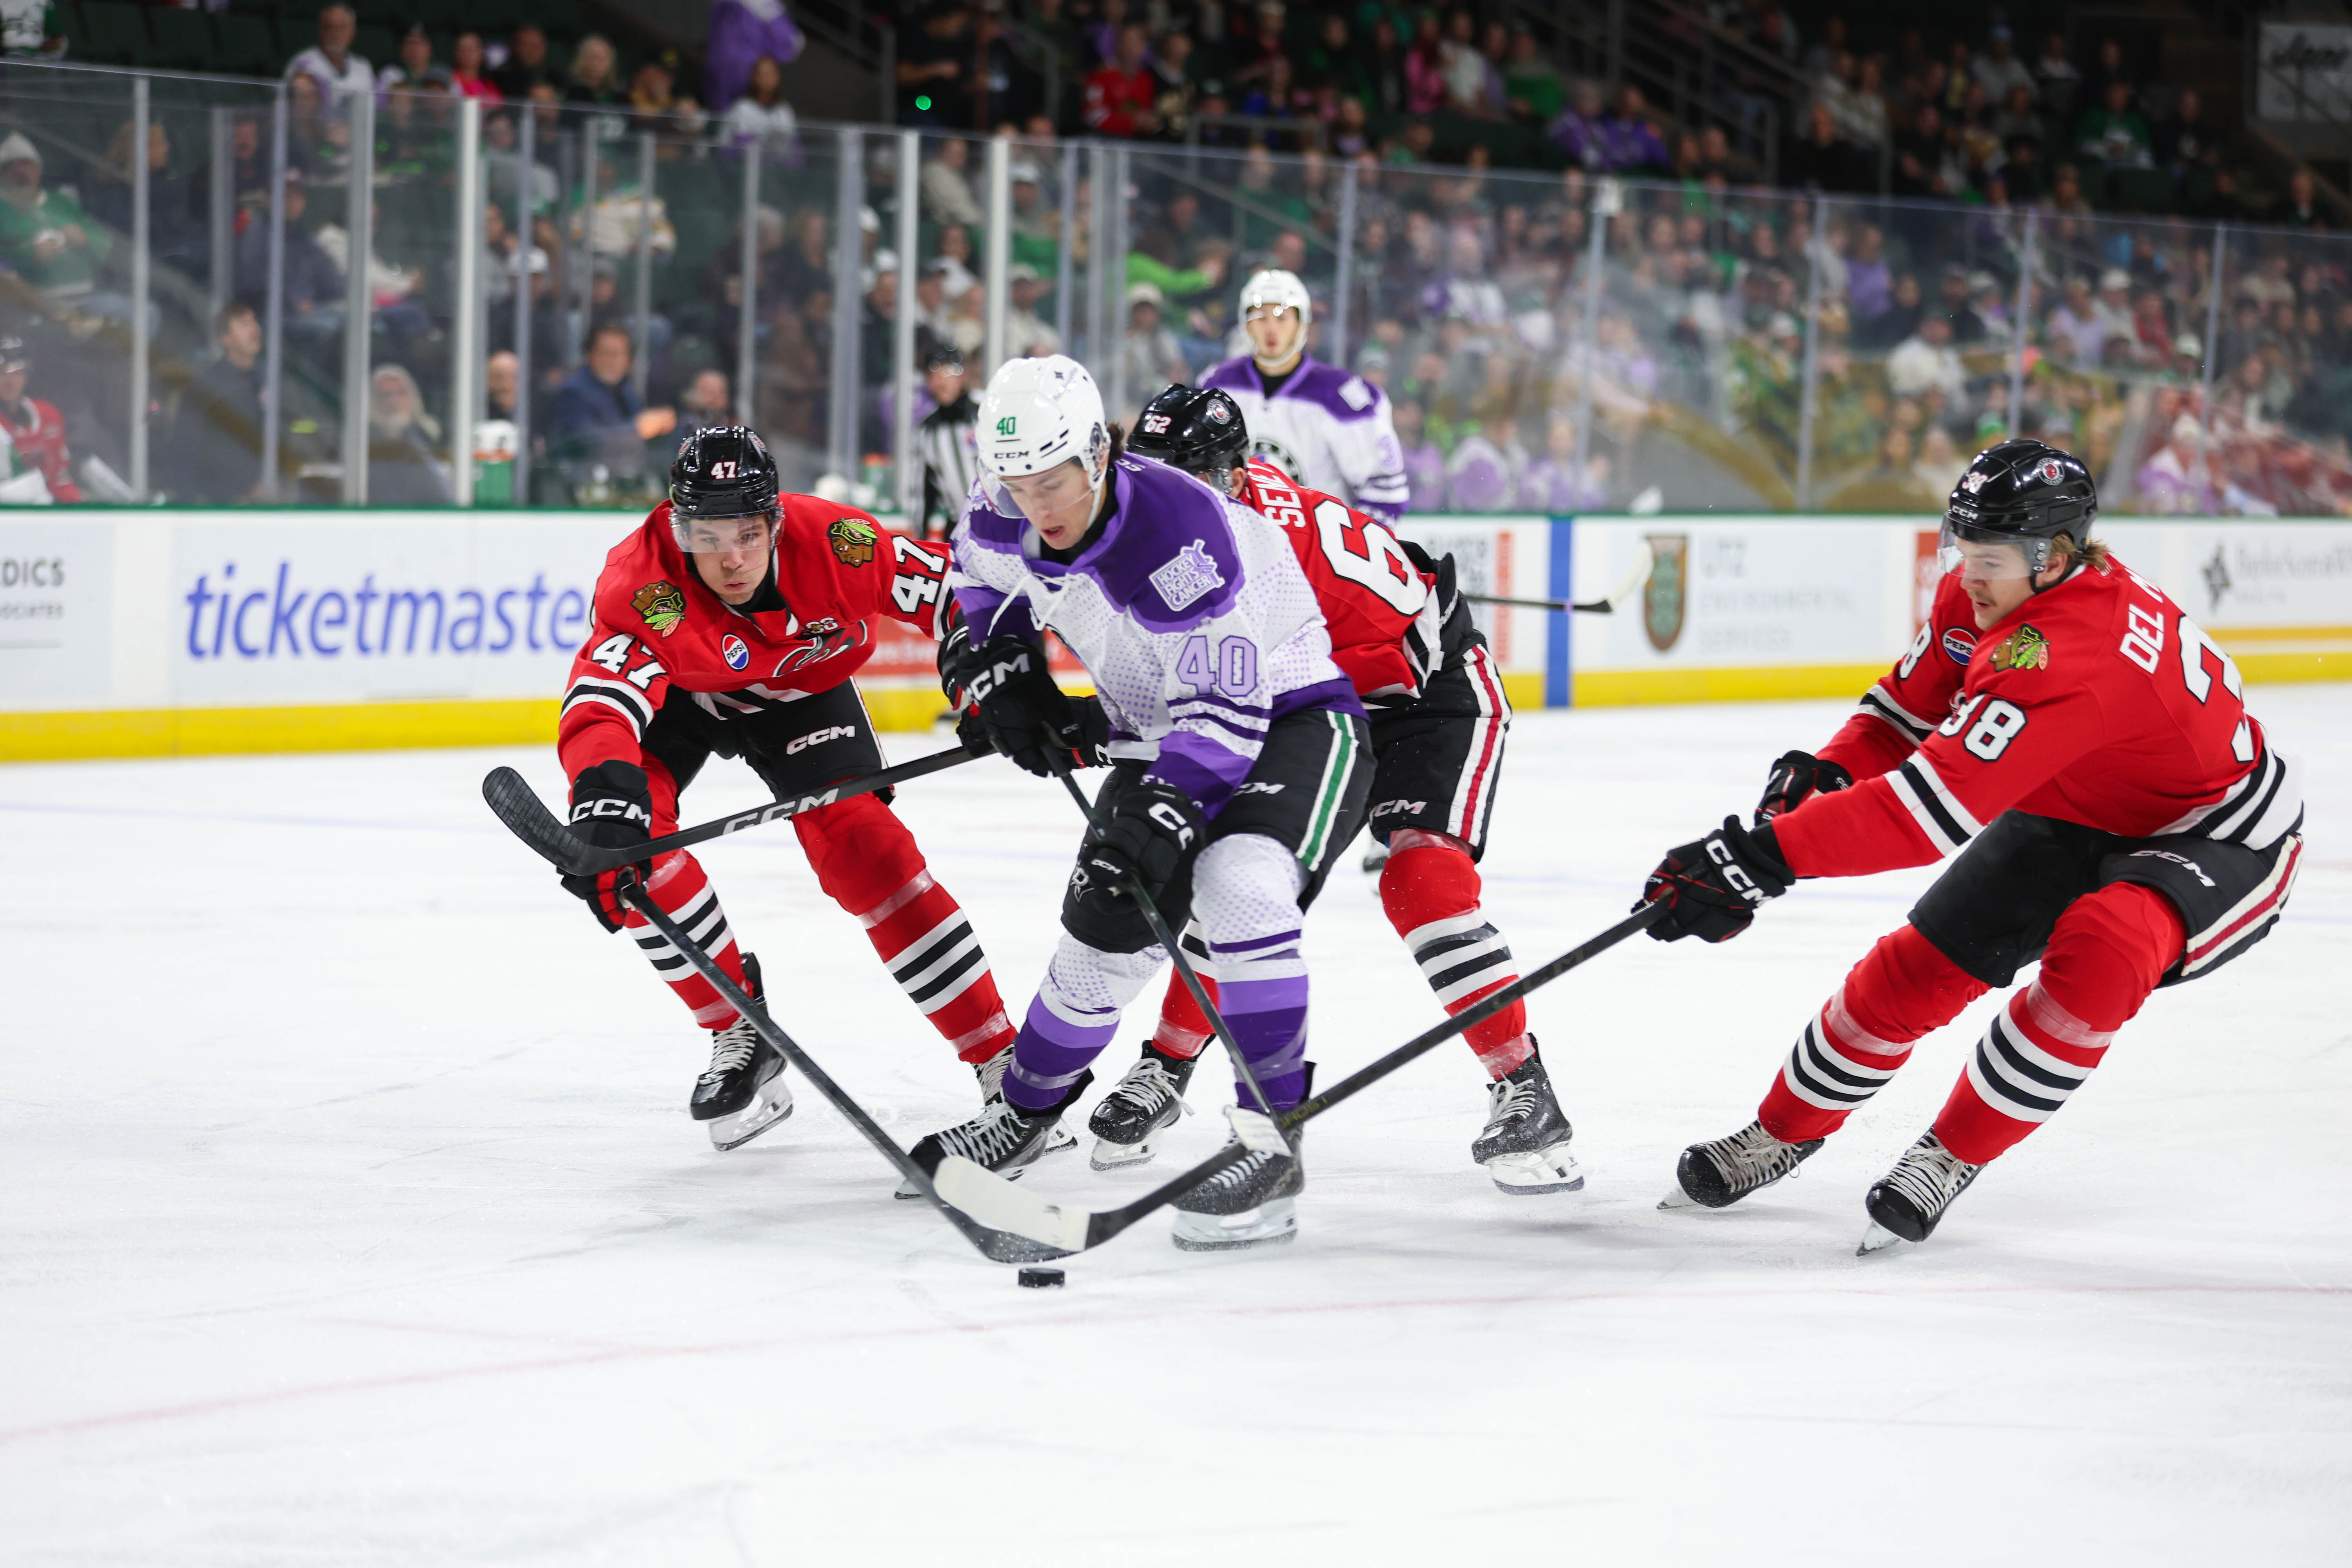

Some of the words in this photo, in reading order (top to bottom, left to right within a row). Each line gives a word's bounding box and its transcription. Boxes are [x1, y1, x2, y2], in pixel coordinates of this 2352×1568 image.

[996, 416, 1016, 436] 40
[1143, 415, 1173, 435] 62
[710, 461, 737, 479] 47
[994, 451, 1029, 459] CCM
[1961, 471, 1989, 494] 38
[1952, 505, 1978, 520] CCM
[1156, 554, 1196, 587] HOCKEY
[1313, 496, 1428, 617] 6
[0, 558, 64, 587] DICS
[890, 534, 947, 615] 47
[1162, 568, 1200, 597] FIGHTS
[1171, 575, 1211, 606] CANCER
[185, 561, 585, 658] ticketmaste
[726, 643, 745, 661] PEPSI
[1945, 637, 1973, 654] PEPS
[2119, 603, 2164, 674] DEL
[591, 632, 669, 693] 47
[1176, 635, 1257, 697] 40
[966, 653, 1031, 706] CM
[786, 725, 855, 755] CCM
[1938, 693, 2027, 762] 38
[1234, 782, 1286, 796] CM
[571, 799, 652, 829] CCM
[722, 788, 839, 836] CCM
[1148, 802, 1194, 850] CC
[1091, 858, 1123, 875] CCM
[1706, 838, 1774, 908] CCM
[2128, 850, 2216, 887] CCM
